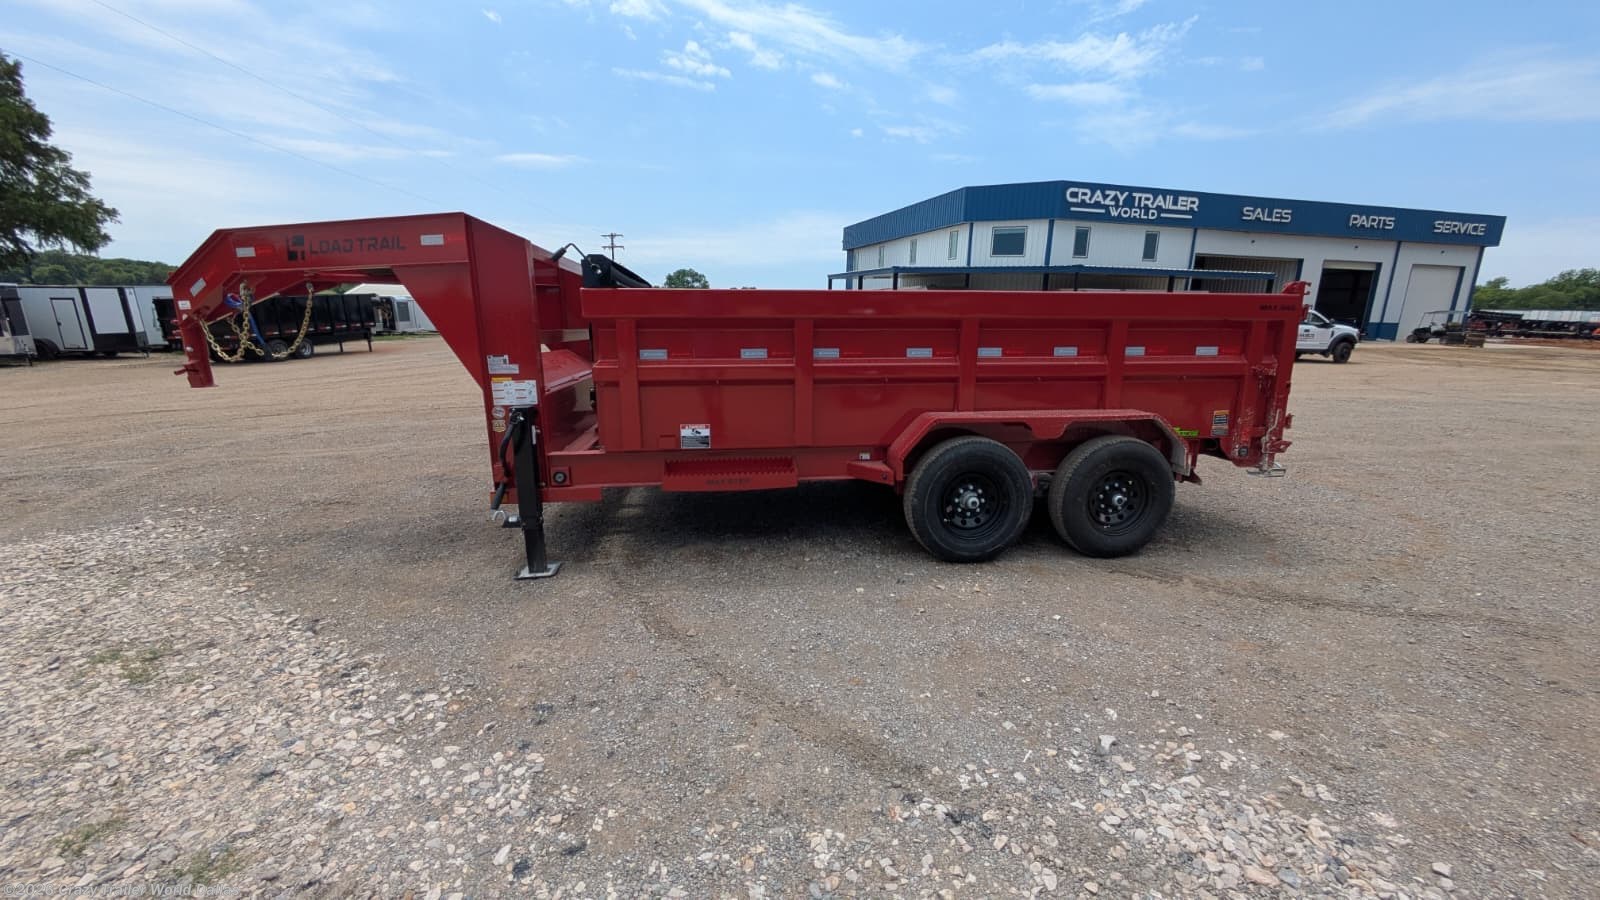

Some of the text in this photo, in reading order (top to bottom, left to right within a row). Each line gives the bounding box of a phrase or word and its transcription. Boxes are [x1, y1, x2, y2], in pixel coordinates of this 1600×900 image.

[1066, 187, 1200, 211] CRAZY TRAILER
[1109, 206, 1158, 219] WORLD
[1242, 207, 1292, 223] SALES
[1349, 214, 1395, 230] PARTS
[1433, 220, 1487, 236] SERVICE
